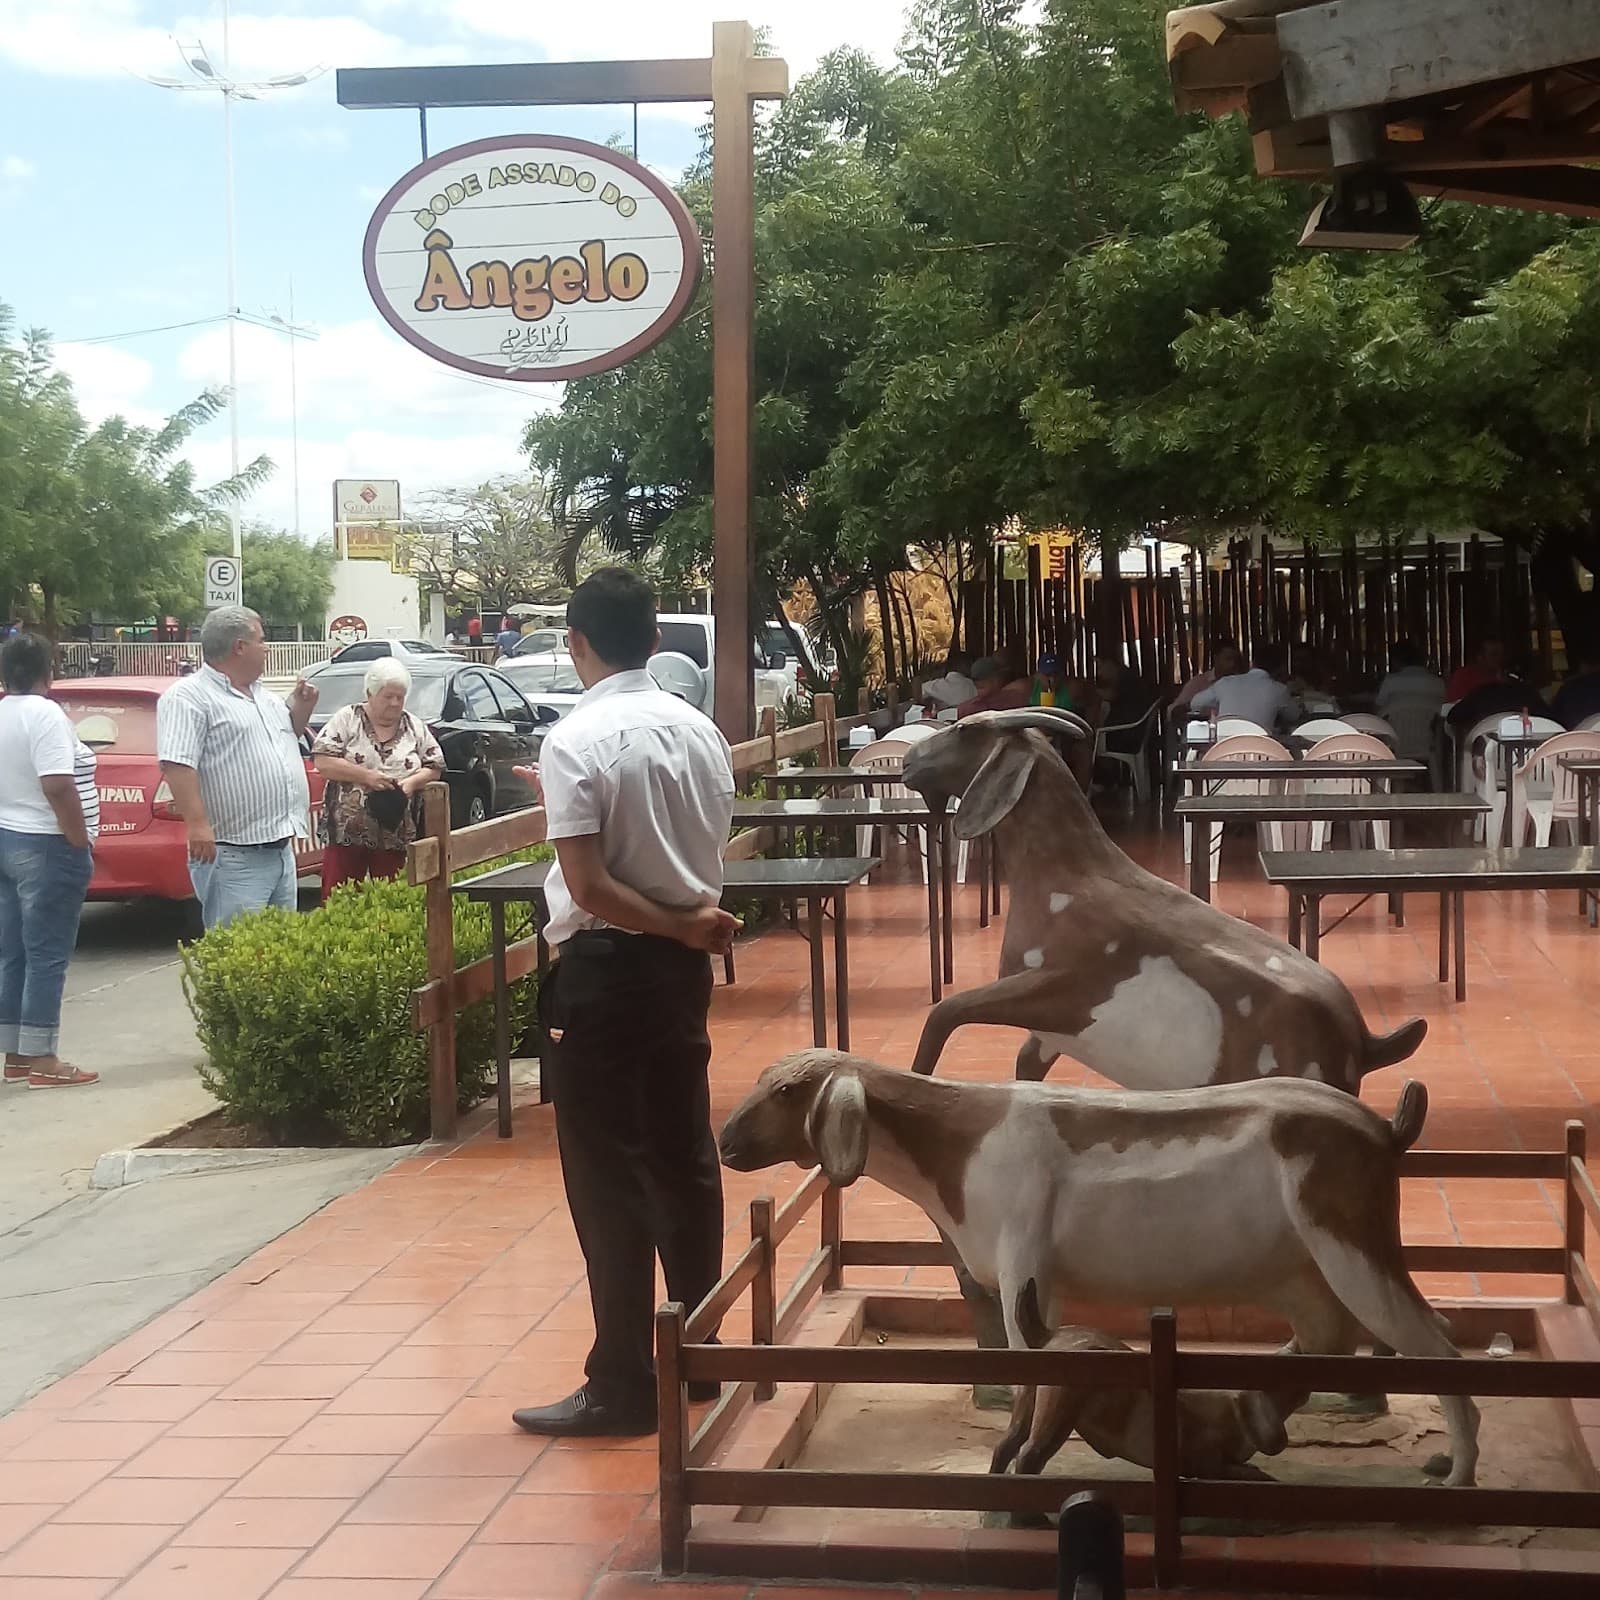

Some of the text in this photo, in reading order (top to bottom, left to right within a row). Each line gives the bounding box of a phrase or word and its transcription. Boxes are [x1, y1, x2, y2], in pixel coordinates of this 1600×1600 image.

[414, 163, 637, 231] BODE ASSADO DO
[414, 228, 649, 322] Ângelo
[217, 566, 229, 581] E
[208, 590, 236, 601] TAXI
[99, 787, 145, 803] IPAVA
[98, 821, 137, 832] om.br
